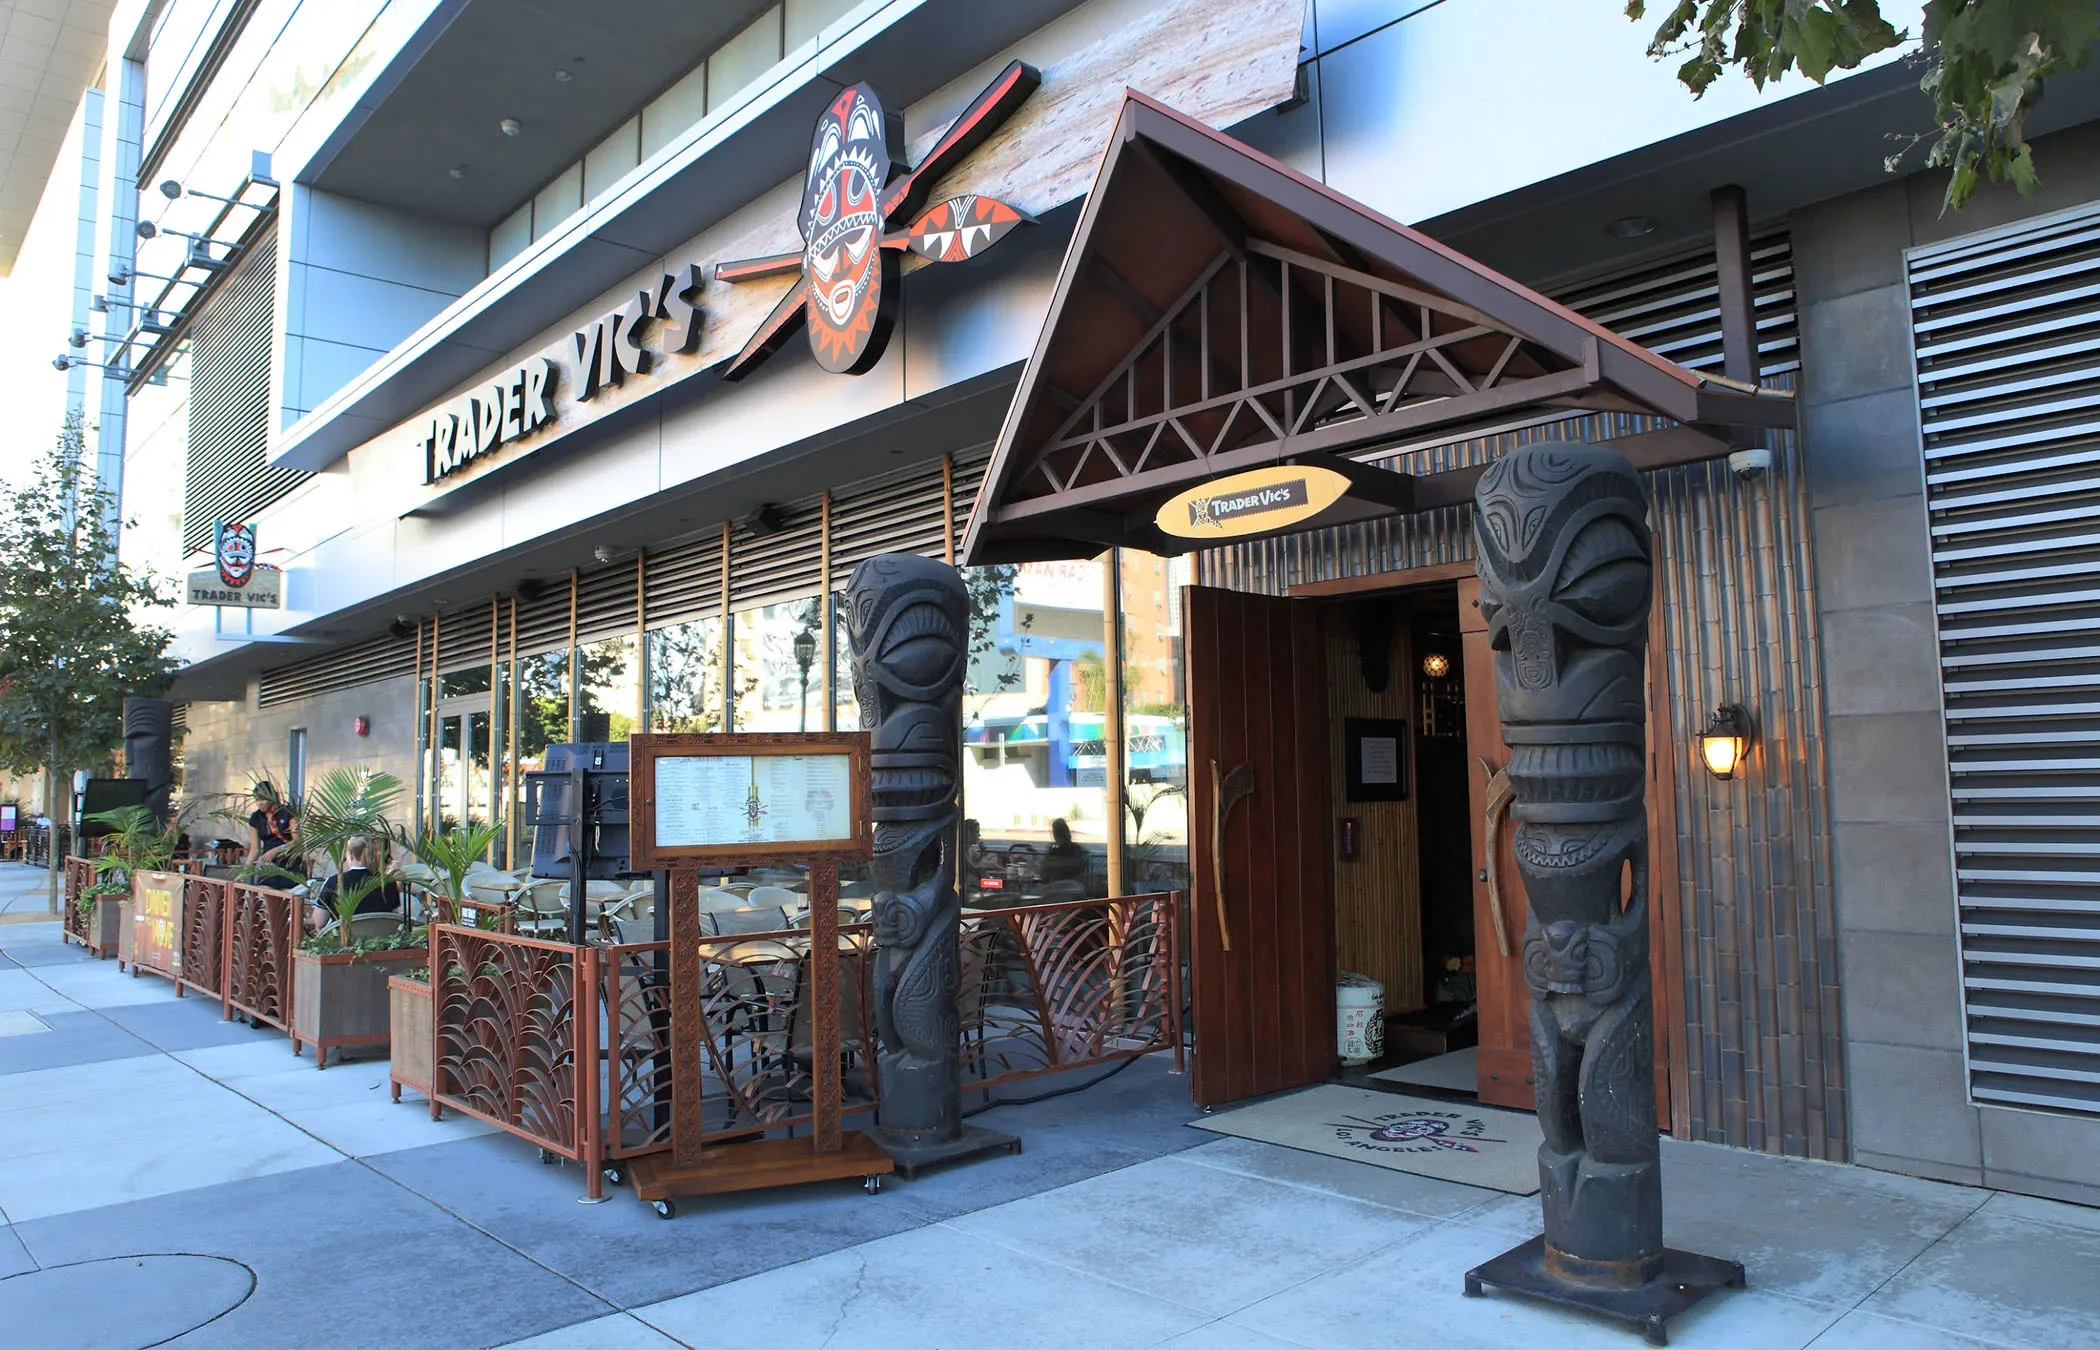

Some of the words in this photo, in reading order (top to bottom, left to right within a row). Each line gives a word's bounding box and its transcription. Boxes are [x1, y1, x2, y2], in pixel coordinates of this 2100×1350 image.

[417, 357, 555, 486] TRADER
[568, 264, 704, 403] VIC'S
[1211, 495, 1260, 516] TRADER
[1259, 488, 1291, 506] VIC'S
[192, 589, 242, 602] TRADER
[247, 592, 278, 603] VIC'S
[1374, 1111, 1462, 1121] TRADER
